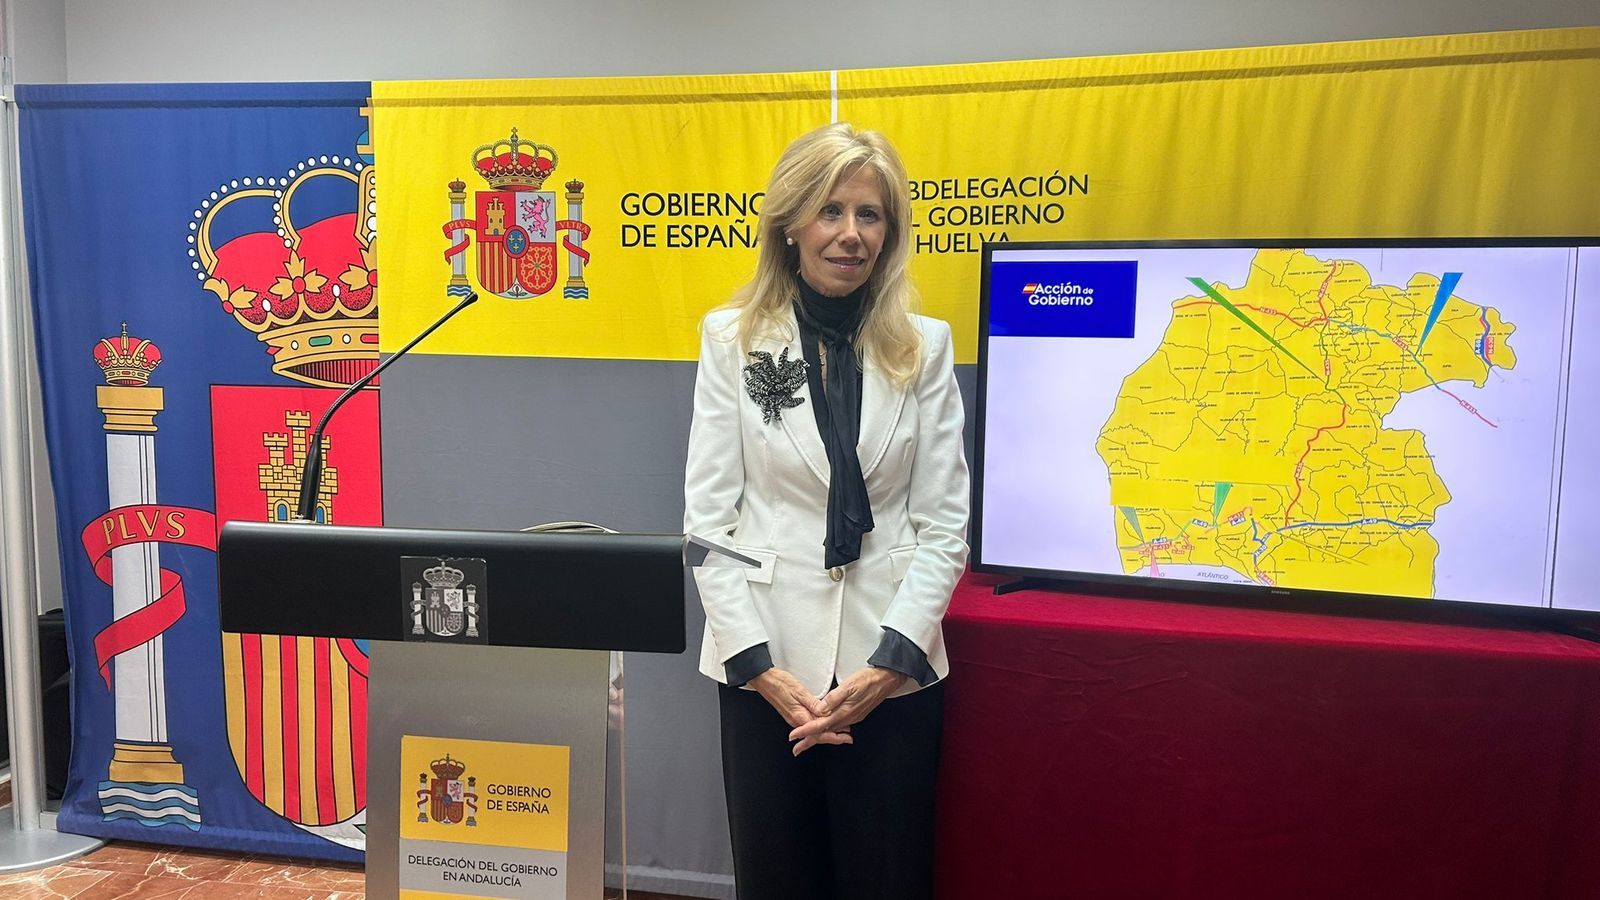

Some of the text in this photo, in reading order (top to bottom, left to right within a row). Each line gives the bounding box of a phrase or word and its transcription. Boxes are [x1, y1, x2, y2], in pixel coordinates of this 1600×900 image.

[909, 170, 1089, 201] BDELEGACIÓN
[928, 202, 1065, 228] GOBIERNO
[621, 224, 657, 248] DE
[1034, 282, 1094, 295] Acción de
[1028, 294, 1094, 306] Gobierno
[101, 509, 186, 546] PLVS
[487, 784, 551, 799] GOBIERNO
[487, 799, 550, 815] DE ESPAÑA
[408, 854, 558, 877] DELEGACIÓN DEL GOBIERNO
[442, 871, 522, 887] EN ANDALUCÍA
